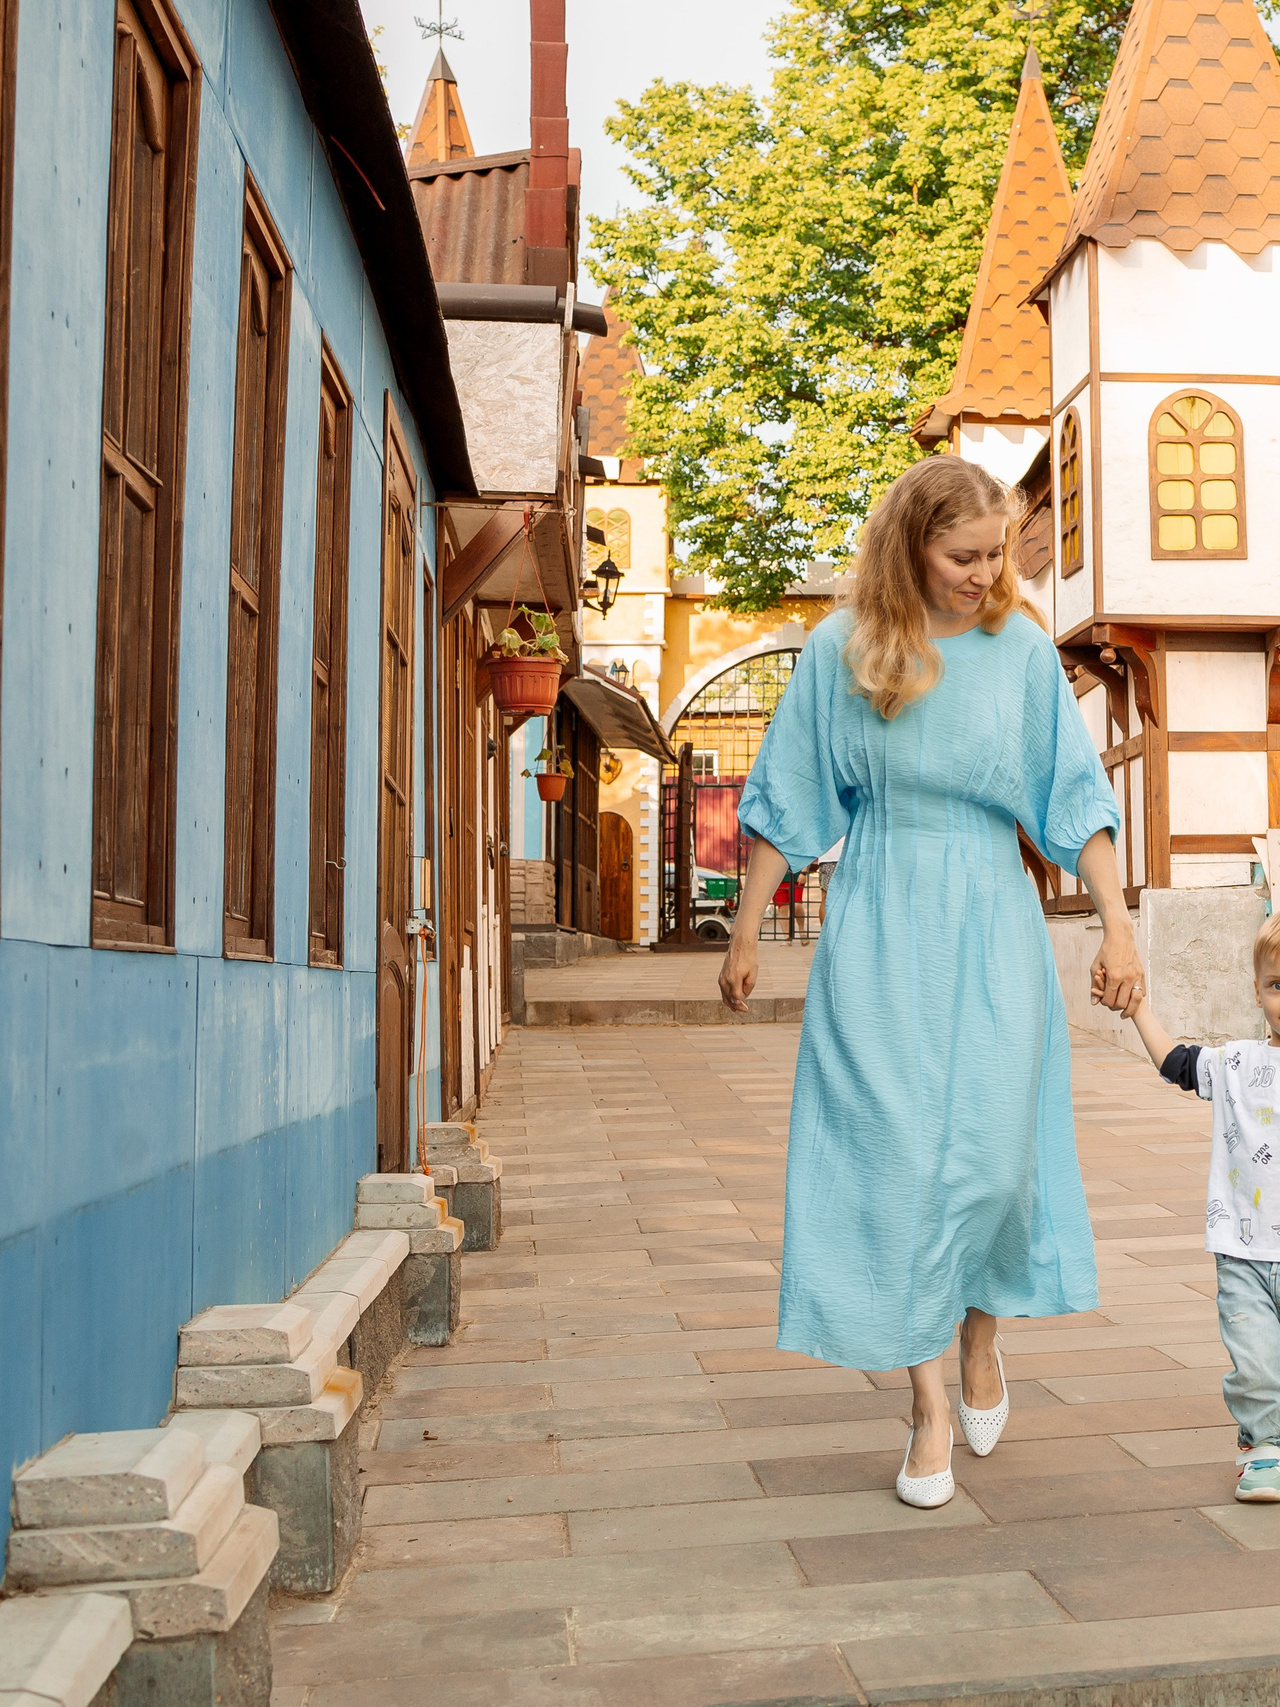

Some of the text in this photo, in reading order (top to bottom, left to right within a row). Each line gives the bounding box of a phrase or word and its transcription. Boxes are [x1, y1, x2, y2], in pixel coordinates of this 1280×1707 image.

[1231, 1059, 1241, 1071] NO
[1248, 1065, 1276, 1088] OK
[1255, 1106, 1274, 1117] RULES
[1260, 1116, 1271, 1126] NO
[1251, 1142, 1270, 1164] RULES
[1260, 1151, 1273, 1165] NO
[1206, 1199, 1231, 1229] OK
